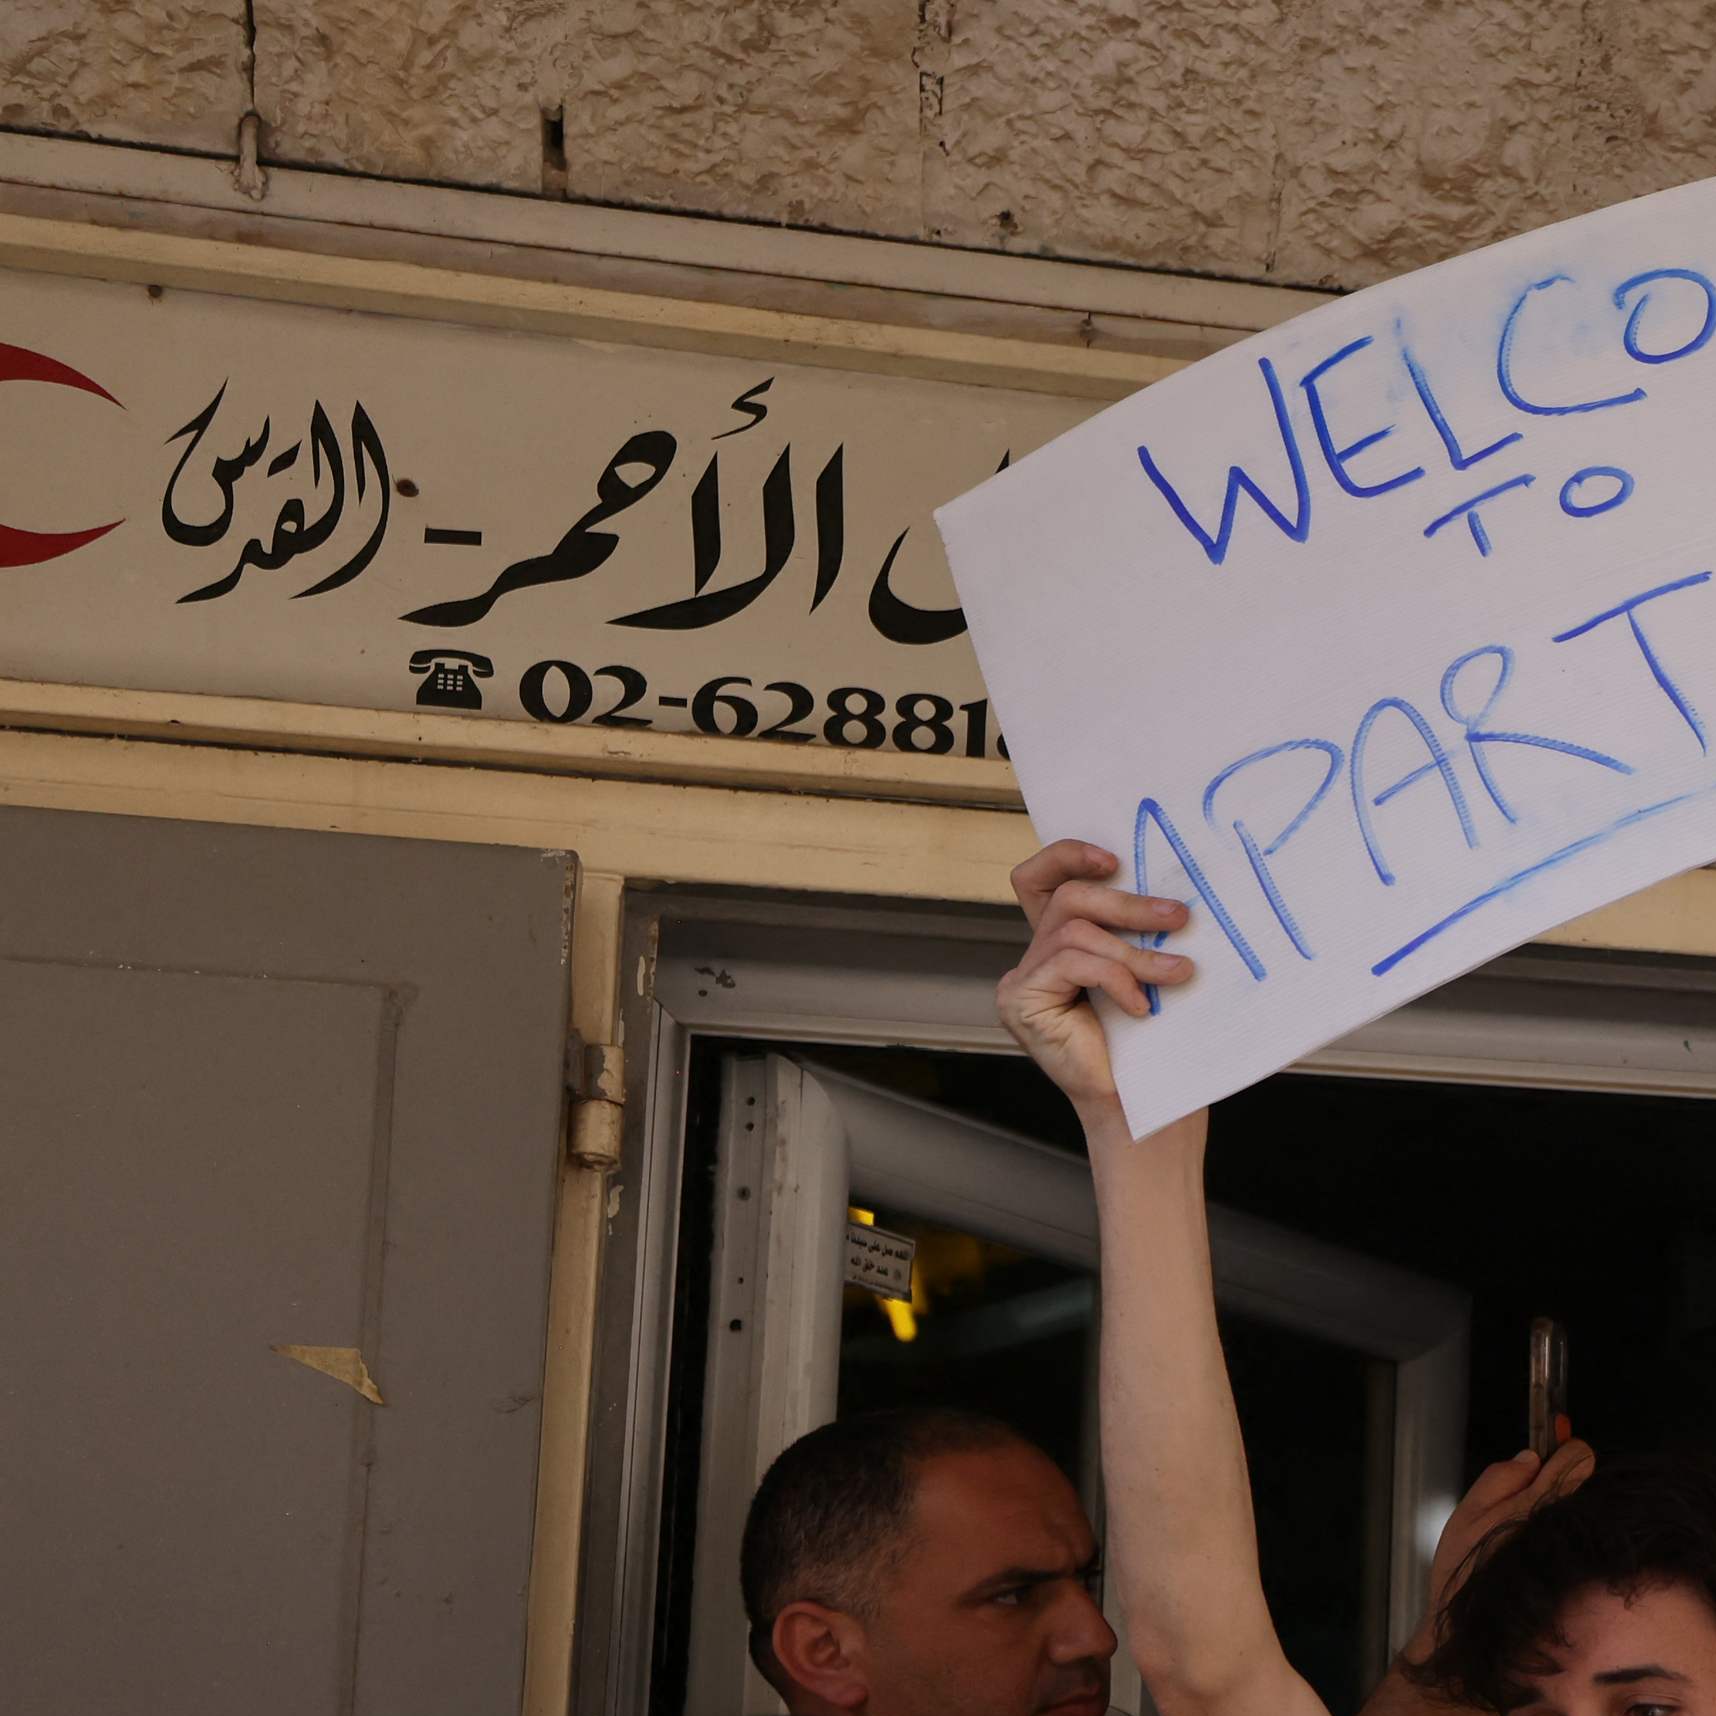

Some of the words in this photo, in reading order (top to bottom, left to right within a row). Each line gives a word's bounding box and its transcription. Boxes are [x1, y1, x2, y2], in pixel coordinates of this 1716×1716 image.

[161, 376, 391, 604] القدس
[398, 376, 843, 629] الأحمر
[1422, 465, 1636, 557] TO
[518, 658, 1011, 761] 02-62881
